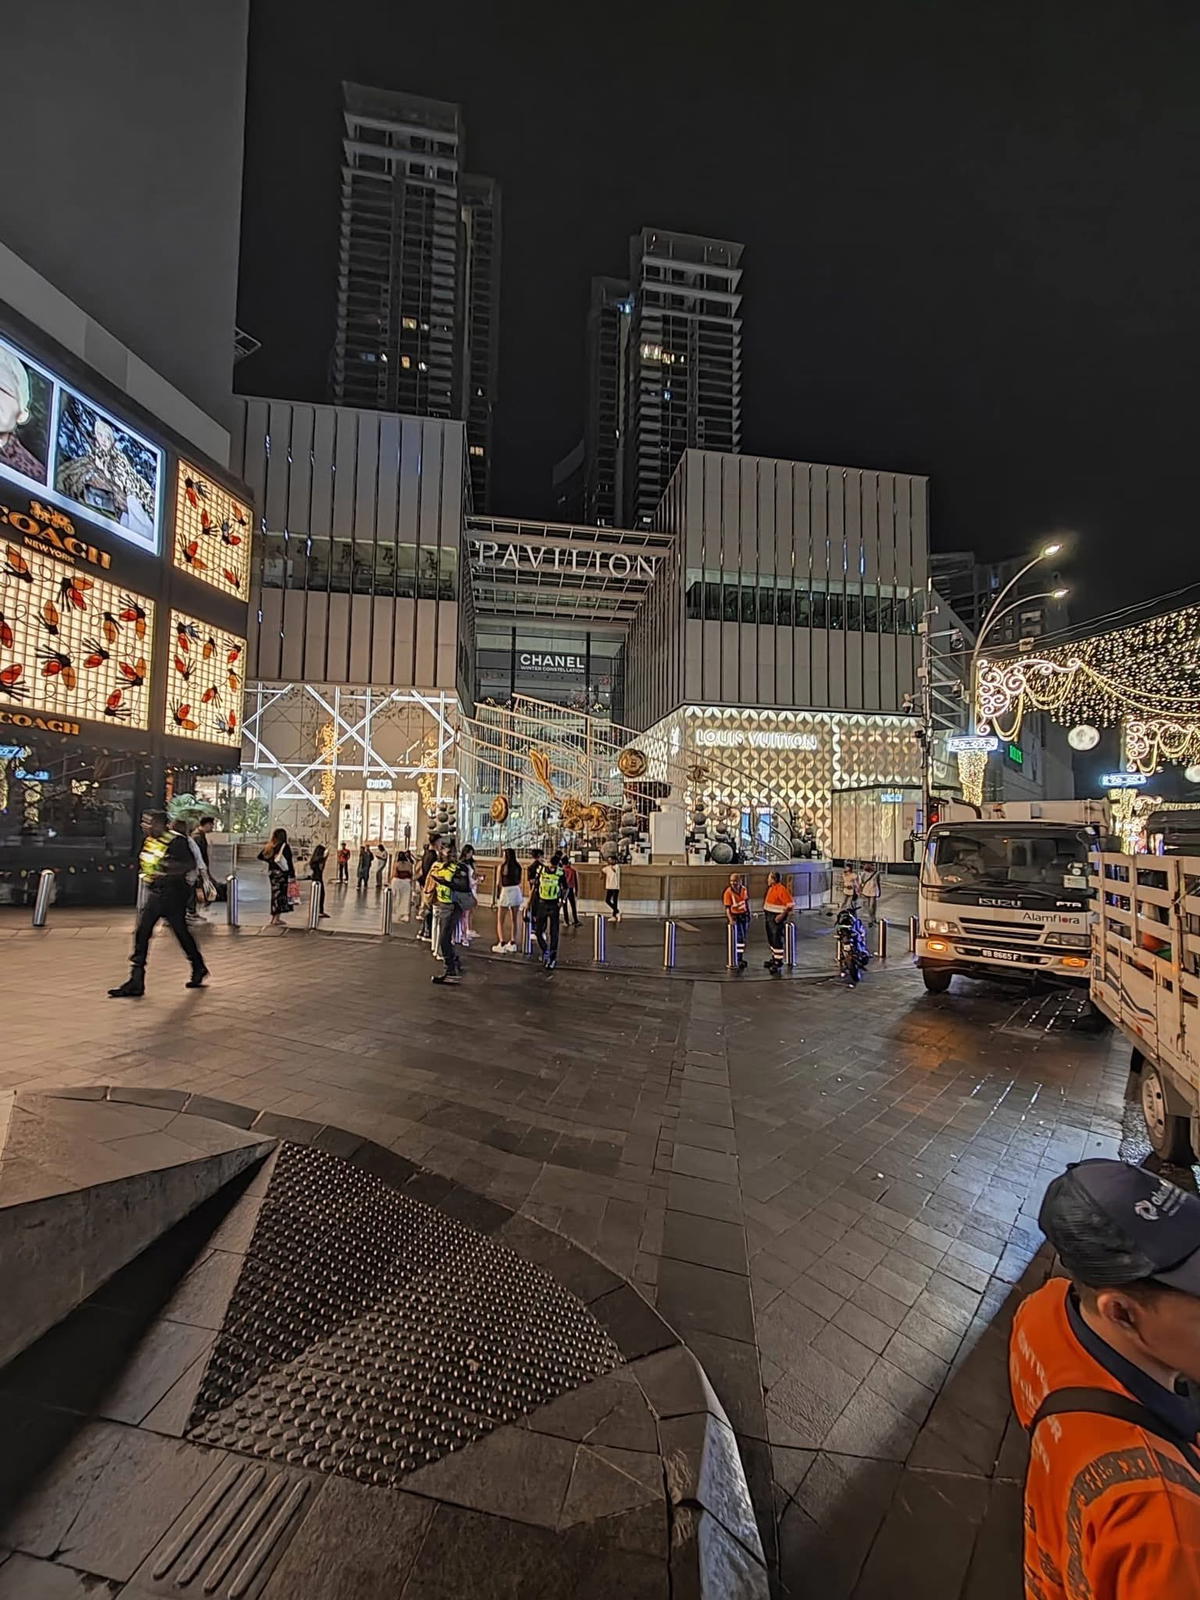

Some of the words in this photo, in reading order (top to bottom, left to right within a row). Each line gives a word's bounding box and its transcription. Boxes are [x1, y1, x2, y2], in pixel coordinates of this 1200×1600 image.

[24, 536, 49, 553] NEW
[49, 547, 76, 564] YORK
[477, 541, 657, 578] PAVILION
[520, 653, 585, 668] CHANEL
[0, 711, 80, 736] COACH
[695, 728, 745, 747] LOUIS
[748, 730, 818, 750] VUITTON
[979, 897, 1023, 907] ISUZU
